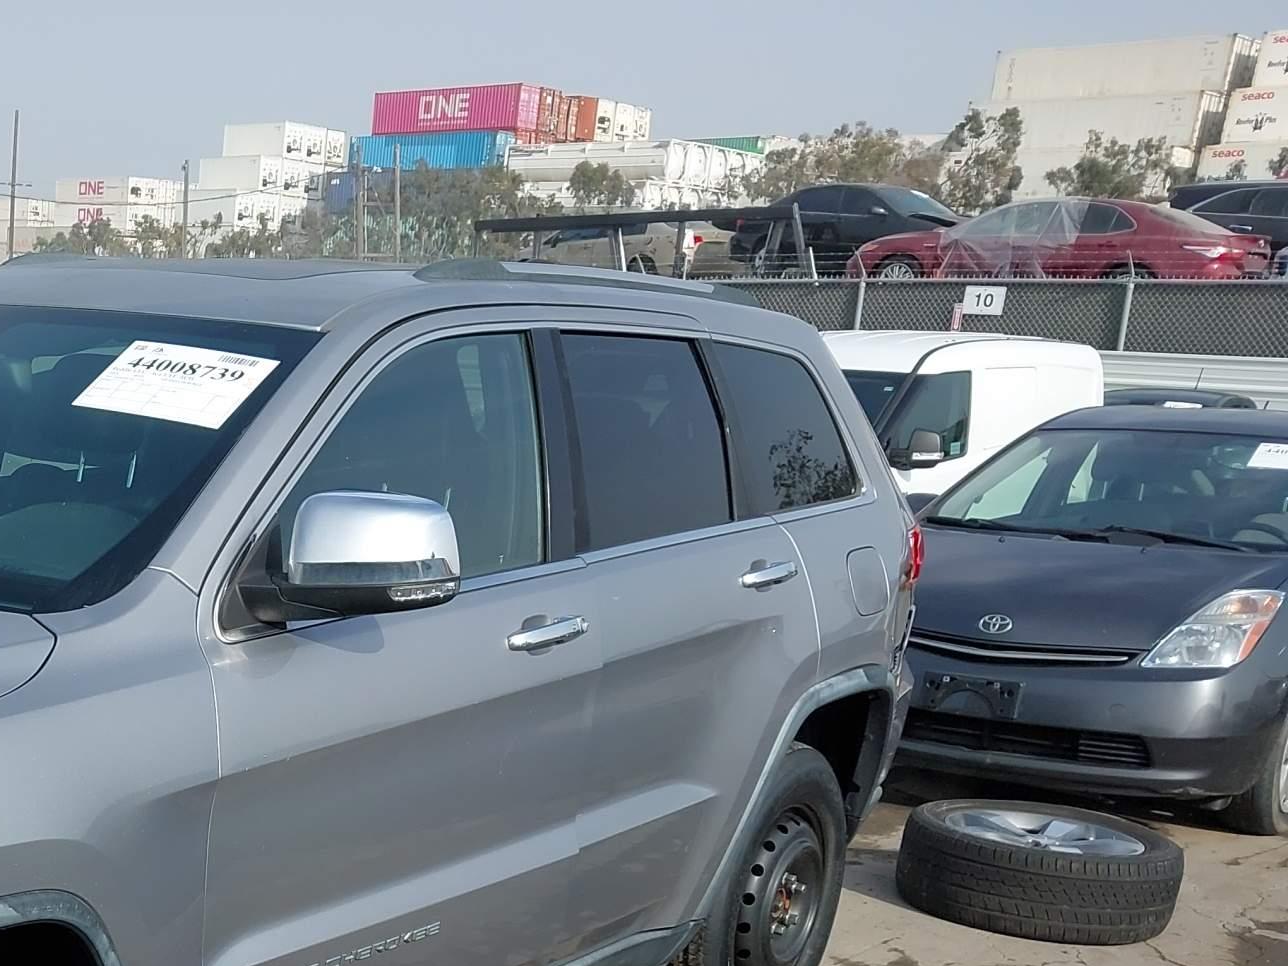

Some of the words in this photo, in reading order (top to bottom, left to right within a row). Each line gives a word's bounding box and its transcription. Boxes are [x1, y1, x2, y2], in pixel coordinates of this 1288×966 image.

[1241, 91, 1275, 102] seaco
[418, 93, 469, 119] ONE
[1212, 149, 1245, 158] seaco
[79, 181, 104, 195] ONE
[975, 293, 994, 308] 10
[128, 356, 245, 383] 44008739
